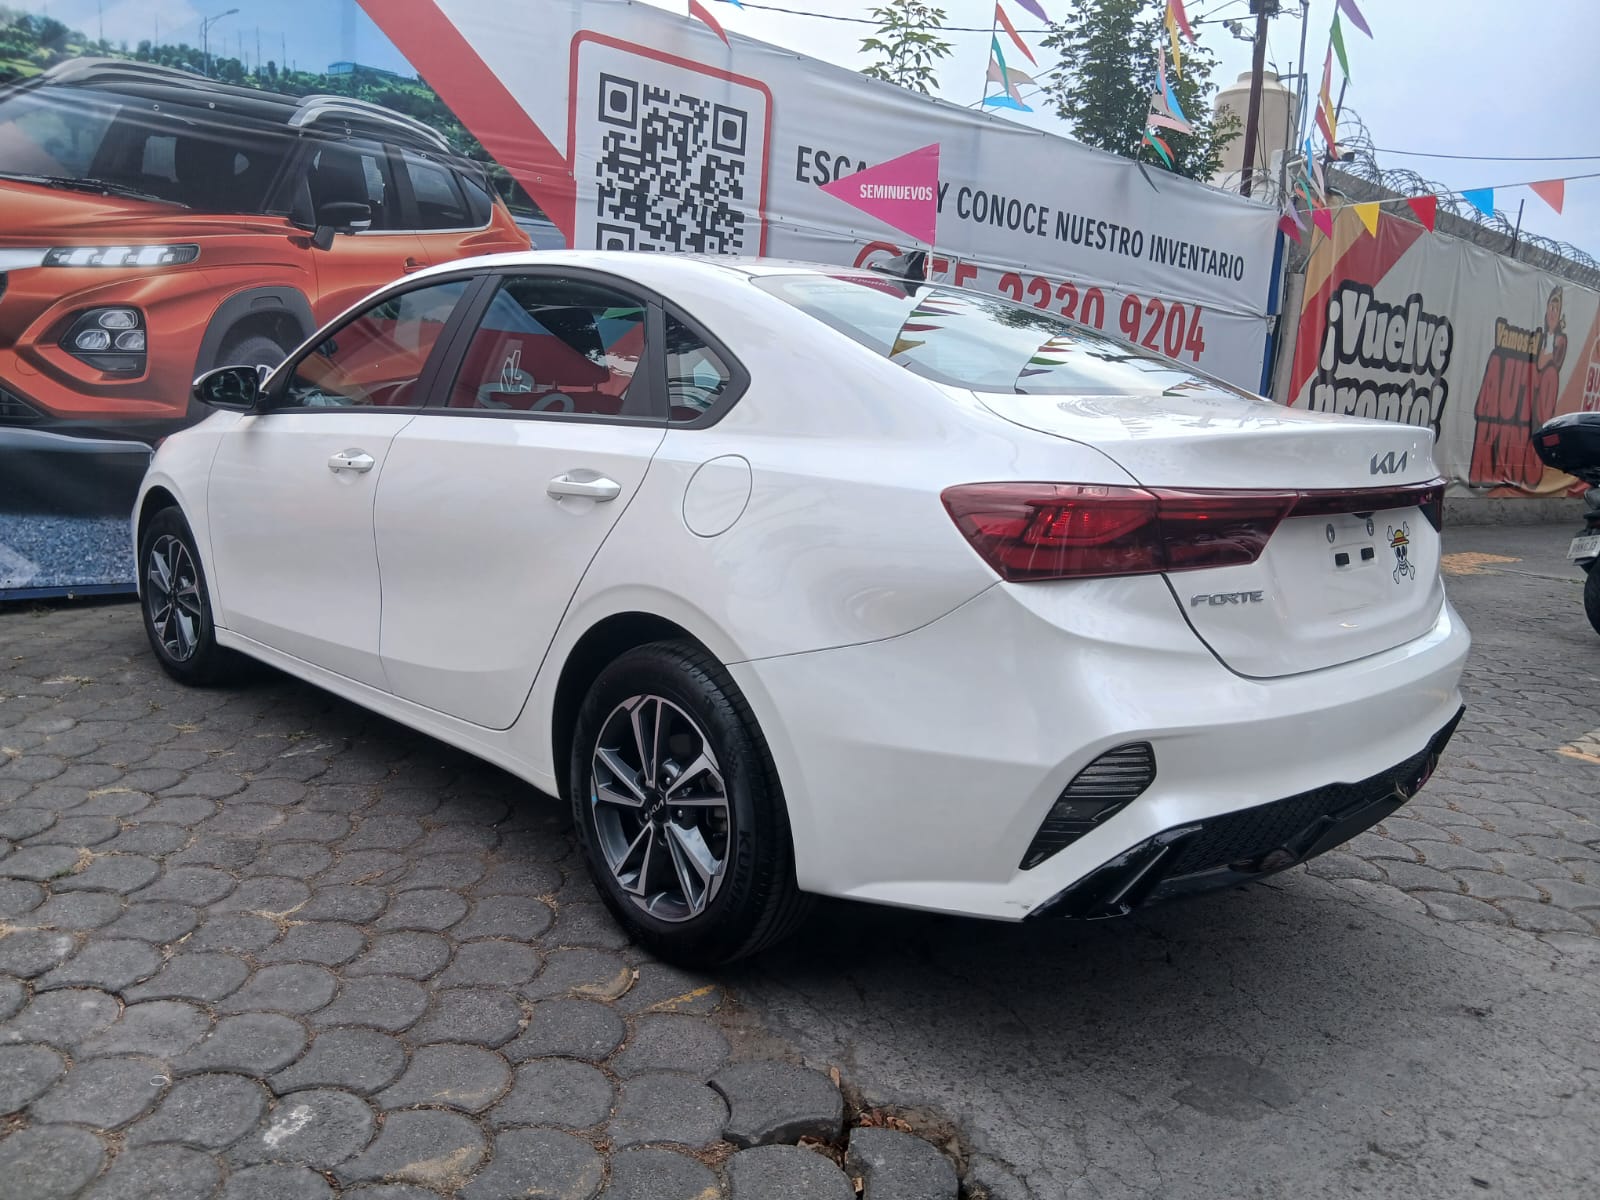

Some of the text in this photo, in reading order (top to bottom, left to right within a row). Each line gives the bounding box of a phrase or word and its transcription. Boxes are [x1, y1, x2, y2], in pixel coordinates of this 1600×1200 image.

[859, 184, 933, 201] SEMINUEVOS
[957, 186, 1049, 237] CONOCE
[1055, 210, 1144, 258] NUESTRO
[1149, 233, 1245, 282] INVENTARIO
[1119, 293, 1205, 362] 9204
[1319, 281, 1451, 373] ¡Vuelve
[1496, 320, 1529, 353] Vamos
[1475, 352, 1559, 424] AUTO
[1370, 452, 1408, 475] KIA
[1191, 590, 1265, 607] FORTE
